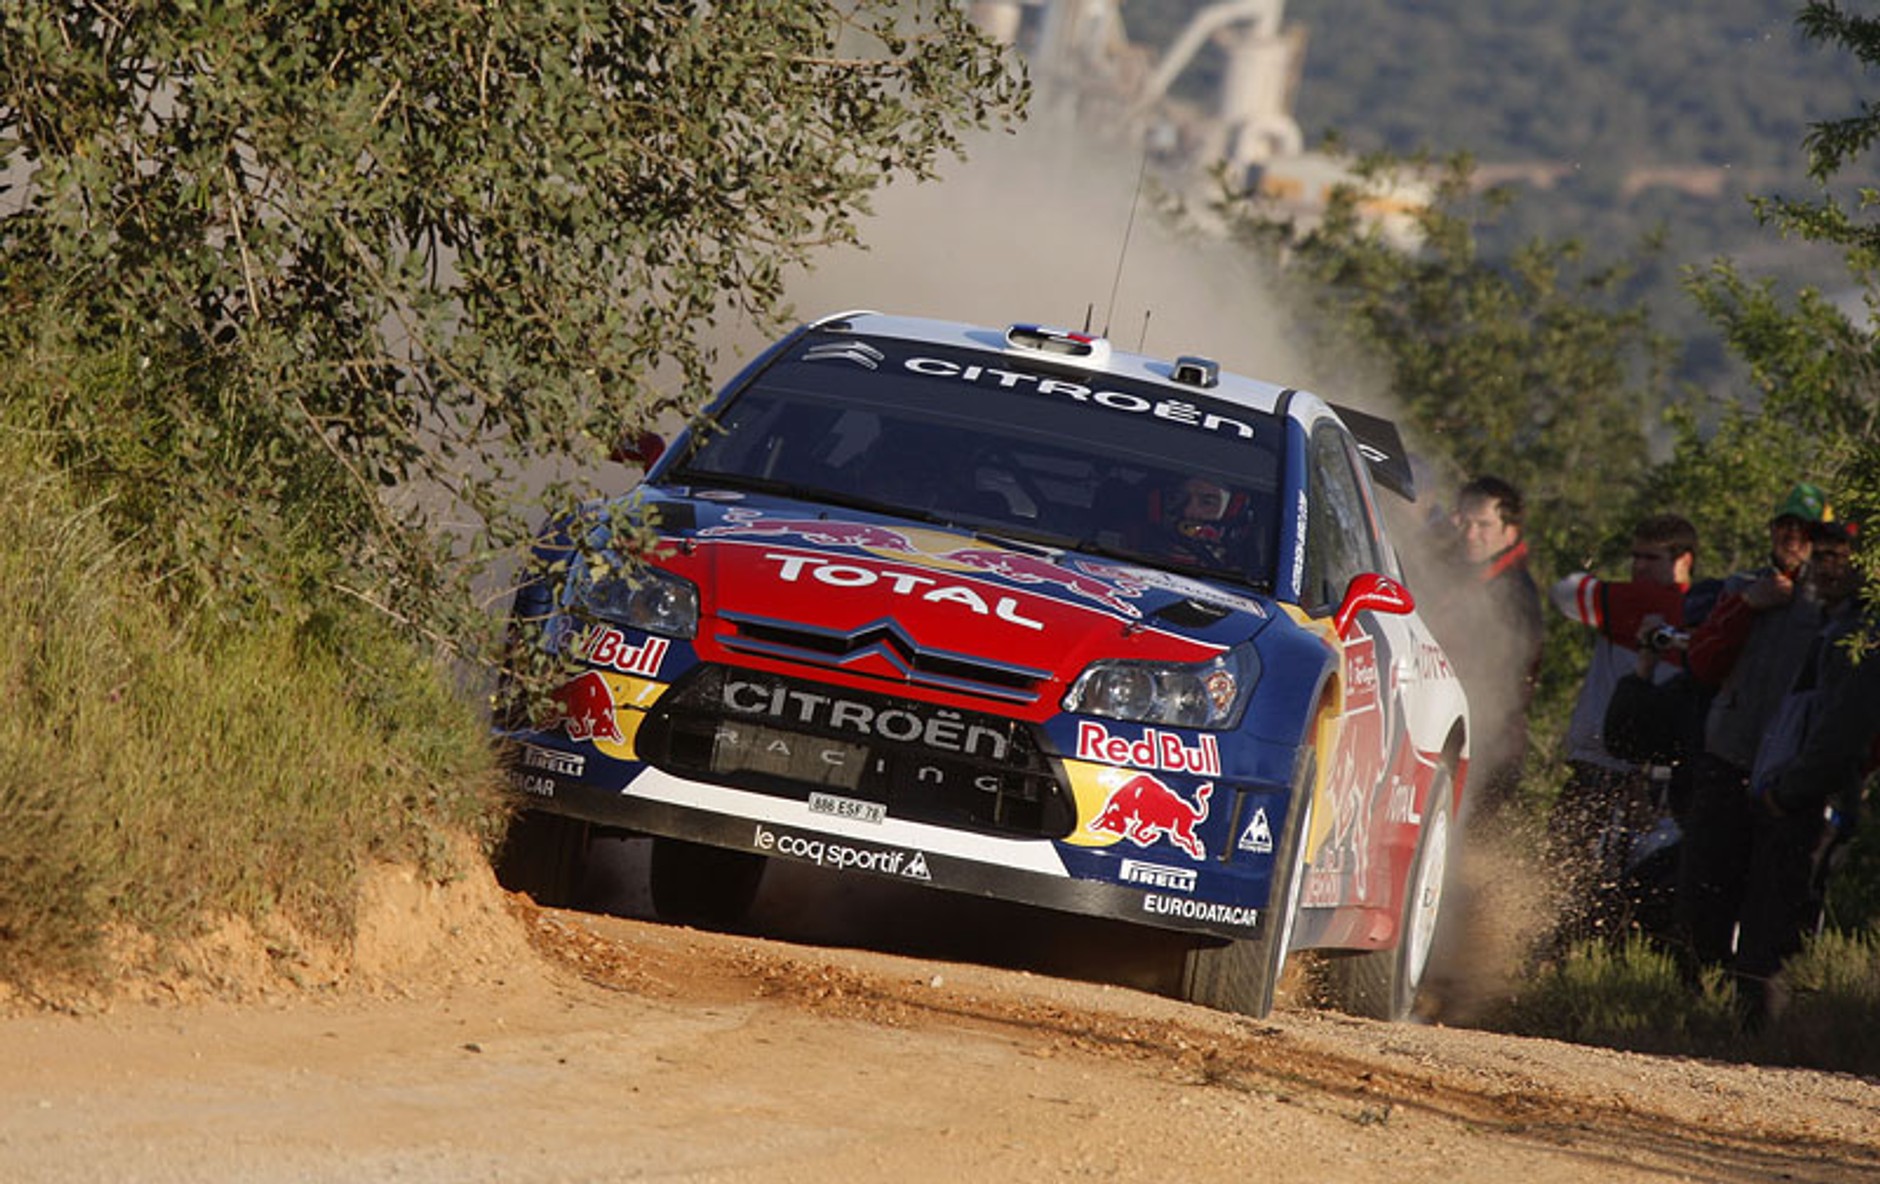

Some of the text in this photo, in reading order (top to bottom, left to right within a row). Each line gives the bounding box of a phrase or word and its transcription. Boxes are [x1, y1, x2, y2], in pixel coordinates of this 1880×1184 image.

[764, 553, 1044, 631] TOTAL
[589, 628, 671, 677] Bull
[1077, 720, 1221, 777] Red Bull
[754, 824, 904, 874] le coq sportif
[1119, 858, 1198, 892] PIRELLI
[1143, 893, 1258, 927] EURODATACAR
